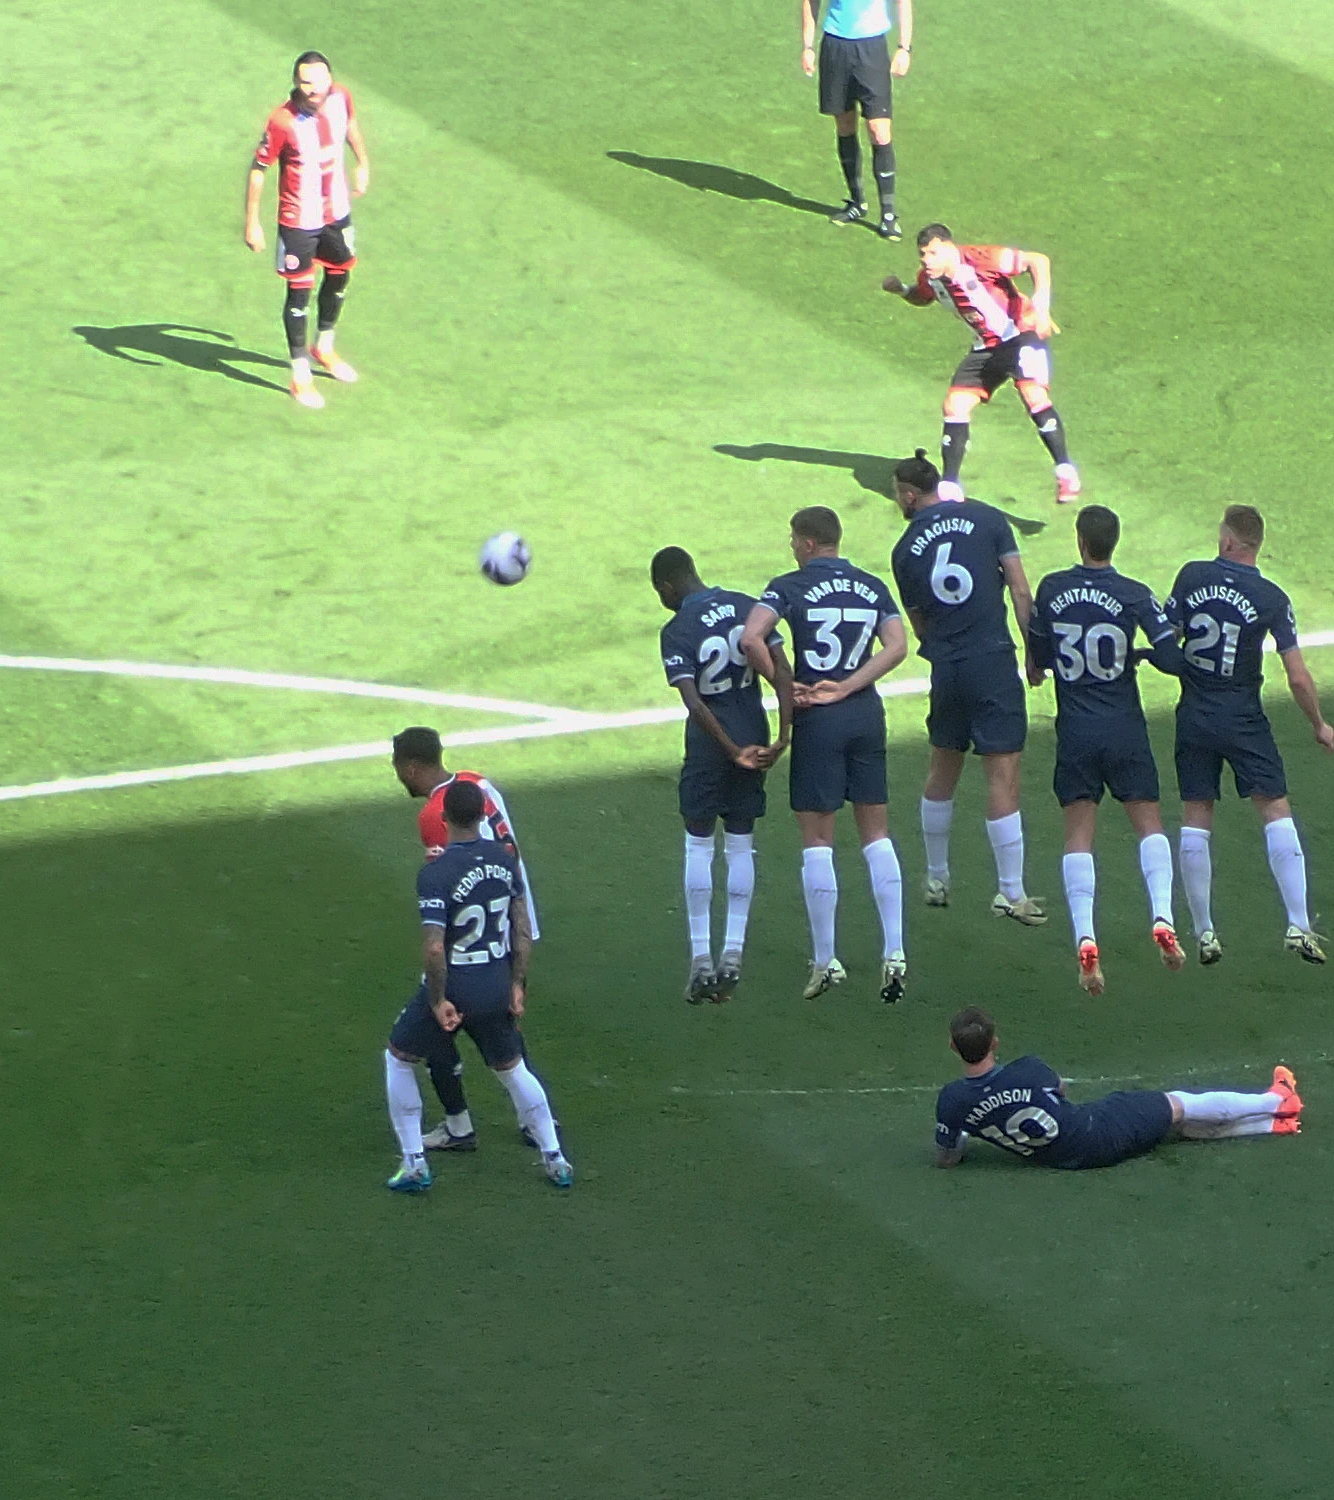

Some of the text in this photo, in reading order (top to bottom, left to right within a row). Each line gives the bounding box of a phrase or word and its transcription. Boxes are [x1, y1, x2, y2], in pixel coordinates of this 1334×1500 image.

[910, 518, 975, 556] DRAGUSIN
[803, 578, 879, 604] VAN DE VEN
[930, 542, 973, 605] 6
[700, 604, 736, 628] SARR
[1049, 588, 1123, 617] BENTANCUR
[1186, 585, 1259, 624] KULUSEVSKI
[698, 624, 757, 695] 29
[803, 607, 878, 672] 37
[1052, 622, 1128, 682] 30
[1184, 612, 1241, 676] 21
[452, 864, 513, 902] PEDRO PORR
[451, 896, 510, 965] 23
[965, 1088, 1032, 1126] MADDISON
[979, 1106, 1059, 1156] 10
